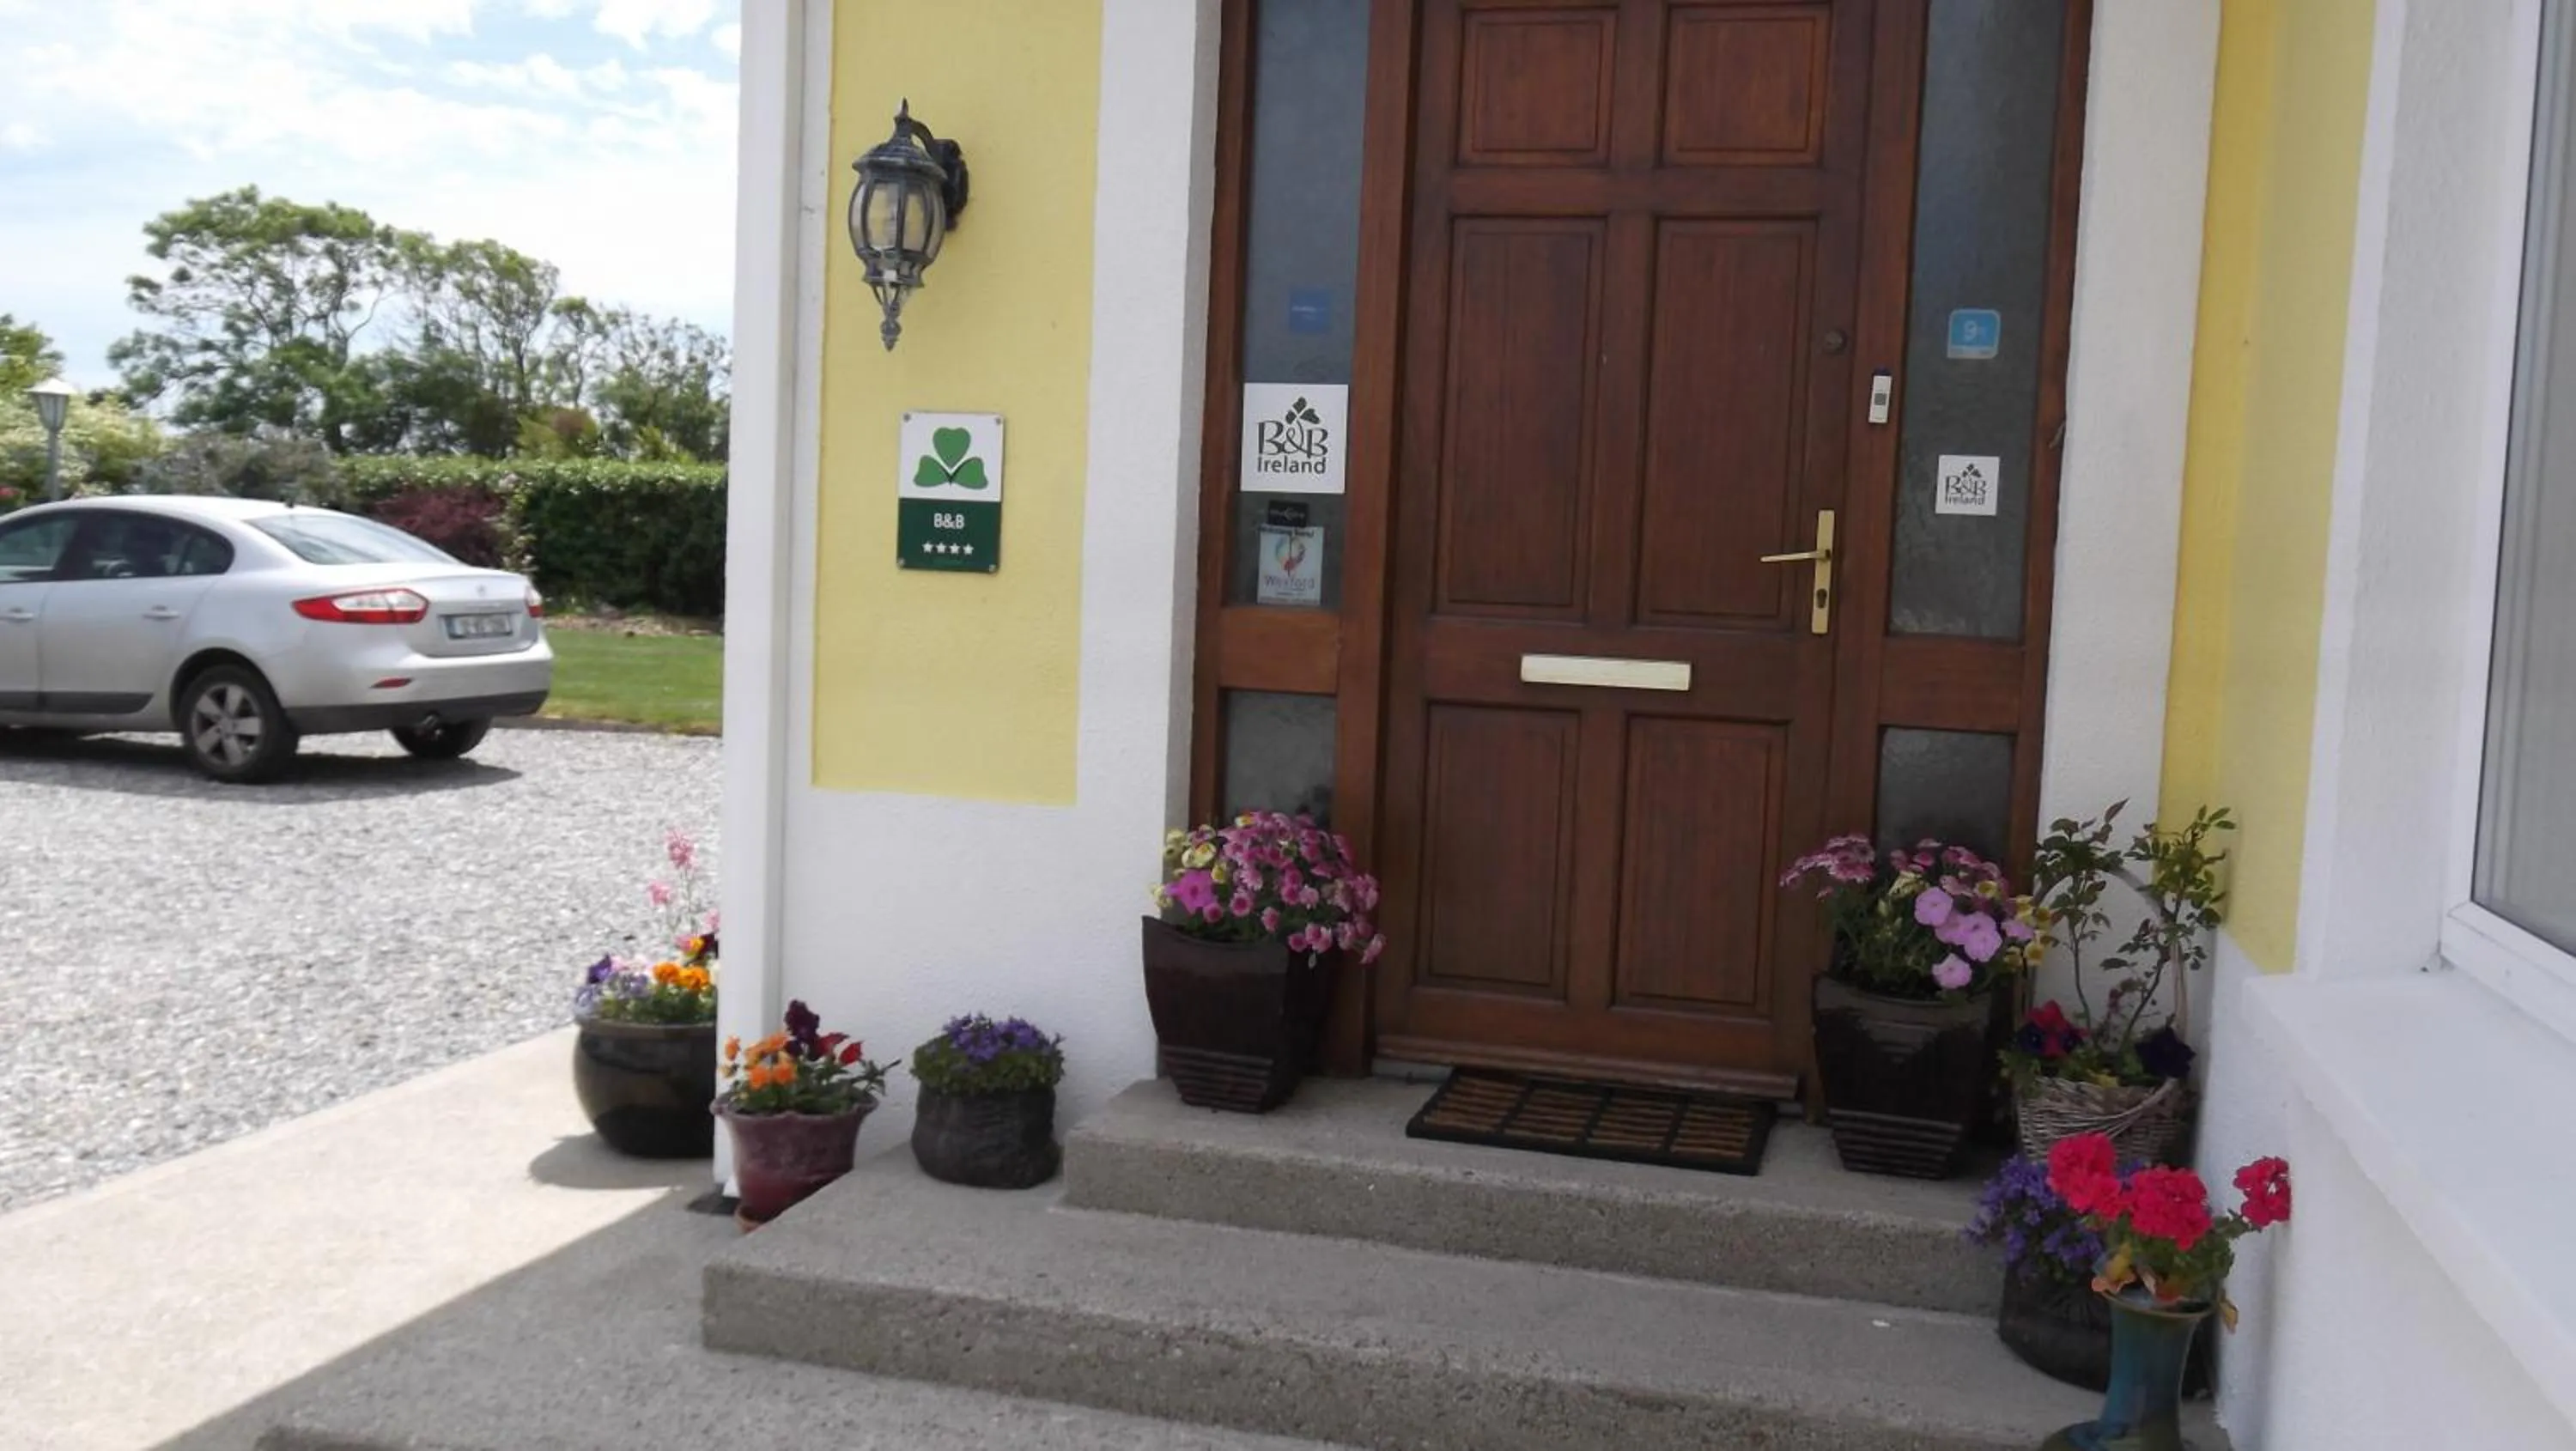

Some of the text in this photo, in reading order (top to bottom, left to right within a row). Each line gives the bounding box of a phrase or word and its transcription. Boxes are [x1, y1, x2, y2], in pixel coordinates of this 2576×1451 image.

[1256, 420, 1329, 458] B&B
[1256, 456, 1327, 475] Ireland
[1945, 475, 1988, 496] B&B
[1944, 495, 1986, 507] Ireland
[933, 513, 966, 530] B&B
